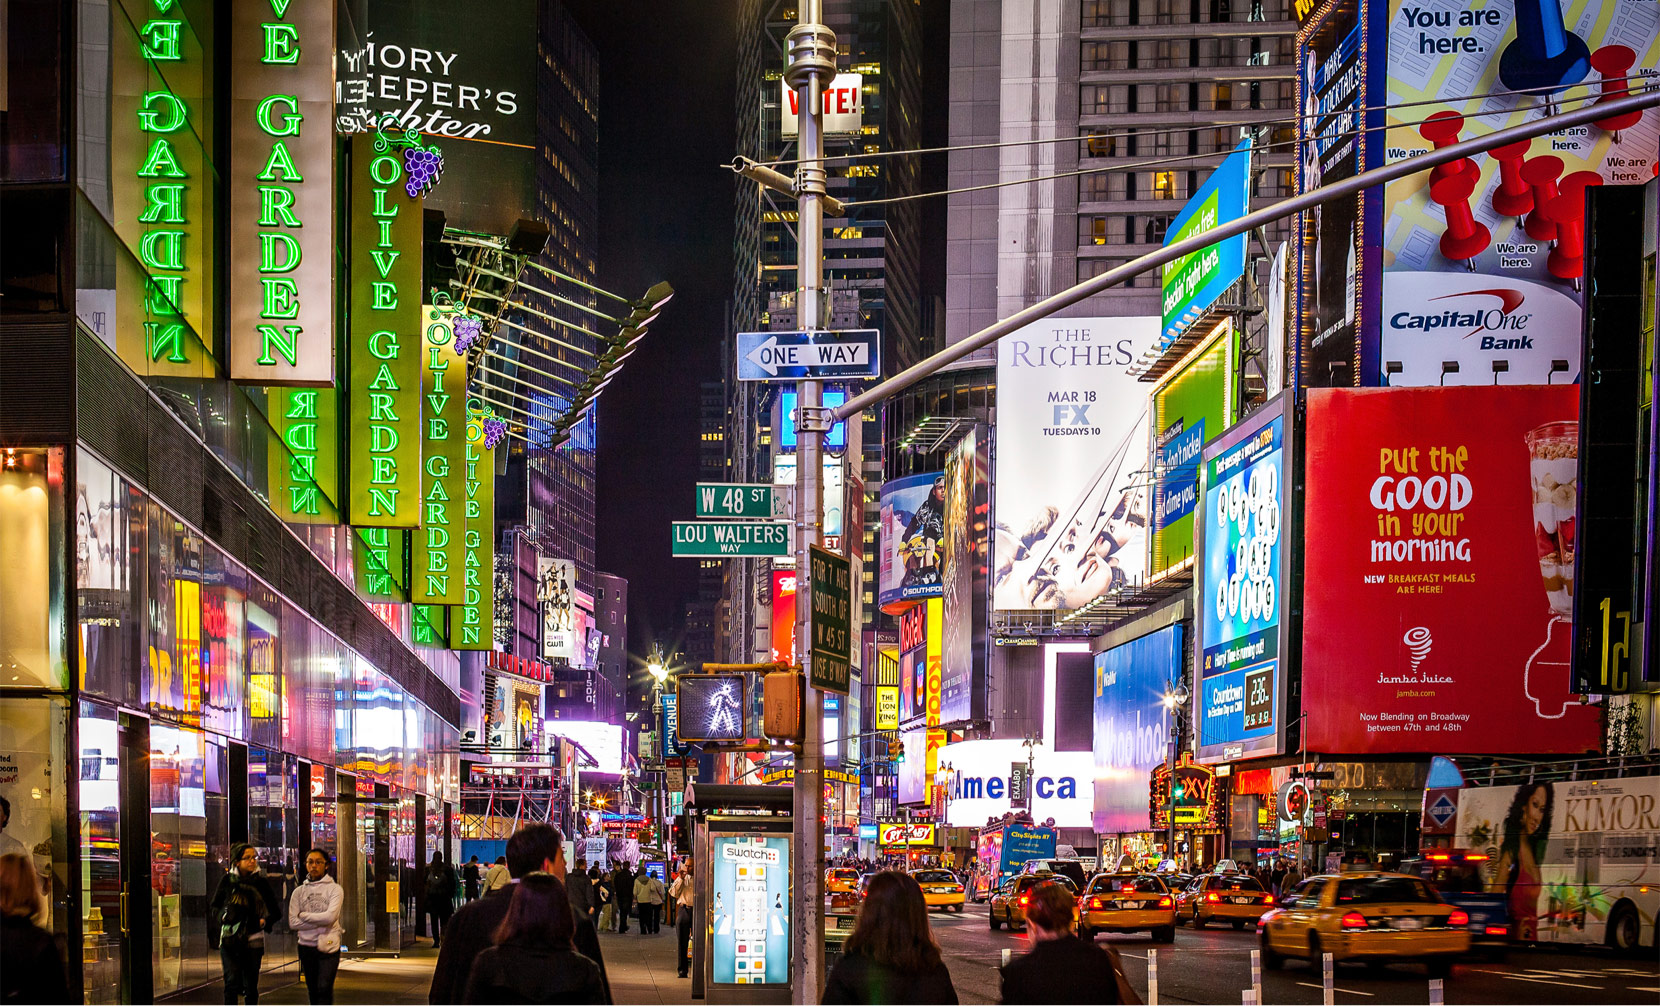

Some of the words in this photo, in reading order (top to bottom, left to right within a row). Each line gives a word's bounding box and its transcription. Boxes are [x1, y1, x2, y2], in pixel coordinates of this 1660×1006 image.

[1403, 7, 1450, 28] You
[1459, 9, 1500, 26] are
[1419, 32, 1485, 54] here.
[367, 73, 518, 115] EEPER'S
[788, 87, 857, 115] VTE!
[1569, 128, 1588, 136] are
[1388, 148, 1404, 158] We
[1607, 157, 1625, 167] We
[1628, 159, 1647, 167] are
[256, 94, 303, 366] GARDEN
[368, 154, 402, 311] OLIVE
[1496, 243, 1513, 254] We
[1516, 245, 1537, 254] are
[1501, 256, 1531, 268] here.
[1052, 328, 1091, 342] THE
[1480, 336, 1534, 350] Bank
[760, 346, 799, 366] ONE
[818, 344, 860, 365] WAY
[426, 323, 451, 441] OLIVE
[1047, 391, 1081, 402] MAR
[1084, 391, 1097, 402] 18
[367, 330, 401, 517] GARDEN
[1053, 405, 1091, 426] FX
[1043, 428, 1091, 436] TUESDAYS
[1092, 428, 1101, 436] 10
[1429, 445, 1469, 472] the
[465, 424, 483, 518] OLIVE
[701, 488, 716, 514] W
[722, 487, 744, 513] 48
[751, 489, 765, 502] ST
[1369, 473, 1473, 511] GOOD
[425, 455, 450, 597] GARDEN
[676, 525, 708, 544] LOU
[713, 525, 785, 544] WALTERS
[1377, 514, 1401, 537] in
[1412, 511, 1465, 537] your
[720, 544, 741, 554] WAY
[812, 557, 827, 583] FOR
[828, 563, 833, 585] 7
[836, 568, 848, 592] AVE
[1364, 575, 1386, 584] NEW
[1388, 573, 1440, 584] BREAKFAST
[1443, 573, 1476, 583] MEALS
[463, 530, 481, 644] GARDEN
[1396, 585, 1416, 594] ARE
[1418, 585, 1444, 594] HERE!
[815, 590, 837, 618] SOUTH
[838, 599, 848, 620] OF
[817, 623, 824, 646] W
[826, 625, 835, 649] 45
[900, 604, 926, 654] Kodak
[814, 655, 827, 681] USE
[829, 660, 848, 685] B'WAY
[1212, 684, 1243, 706] Countdown
[1396, 689, 1436, 699] jamba.com
[879, 702, 896, 712] LION
[879, 713, 896, 723] KING
[1359, 712, 1378, 721] Now
[1380, 712, 1414, 722] Blending
[1430, 712, 1471, 722] Broadway
[1367, 723, 1401, 732] between
[1403, 723, 1422, 732] 47th
[1425, 723, 1440, 732] and
[1442, 723, 1462, 732] 48th
[955, 769, 1077, 800] Ameca
[726, 847, 768, 860] swatch
